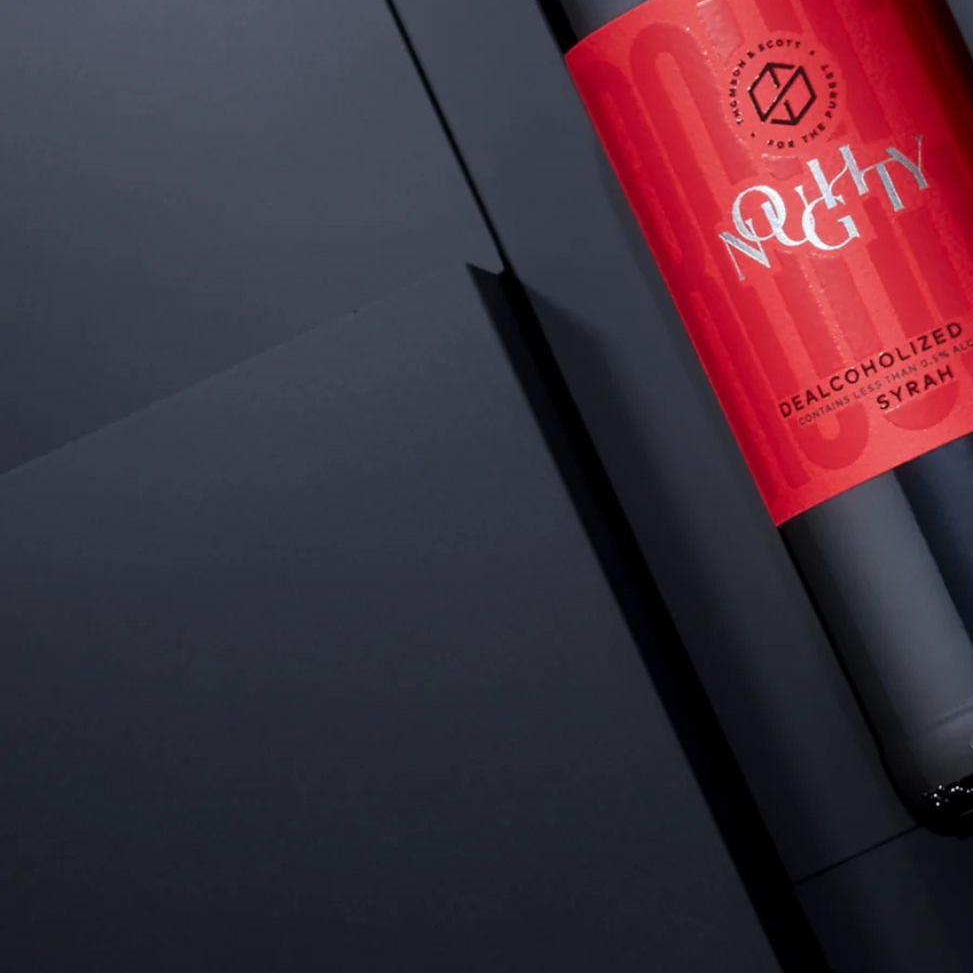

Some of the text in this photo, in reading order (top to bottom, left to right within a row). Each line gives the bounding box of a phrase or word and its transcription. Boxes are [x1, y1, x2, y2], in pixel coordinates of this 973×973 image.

[728, 58, 747, 126] THOMSON
[757, 38, 802, 52] SCOTT
[767, 63, 839, 149] FOR THE PUREST
[718, 134, 931, 281] NOUGHTY
[778, 322, 963, 418] DEALCOHOLIZED
[798, 395, 852, 426] CONTAINS
[852, 380, 883, 400] LESS
[884, 364, 918, 385] THAN
[920, 349, 950, 369] 0.5%
[875, 365, 955, 411] SYRAH
